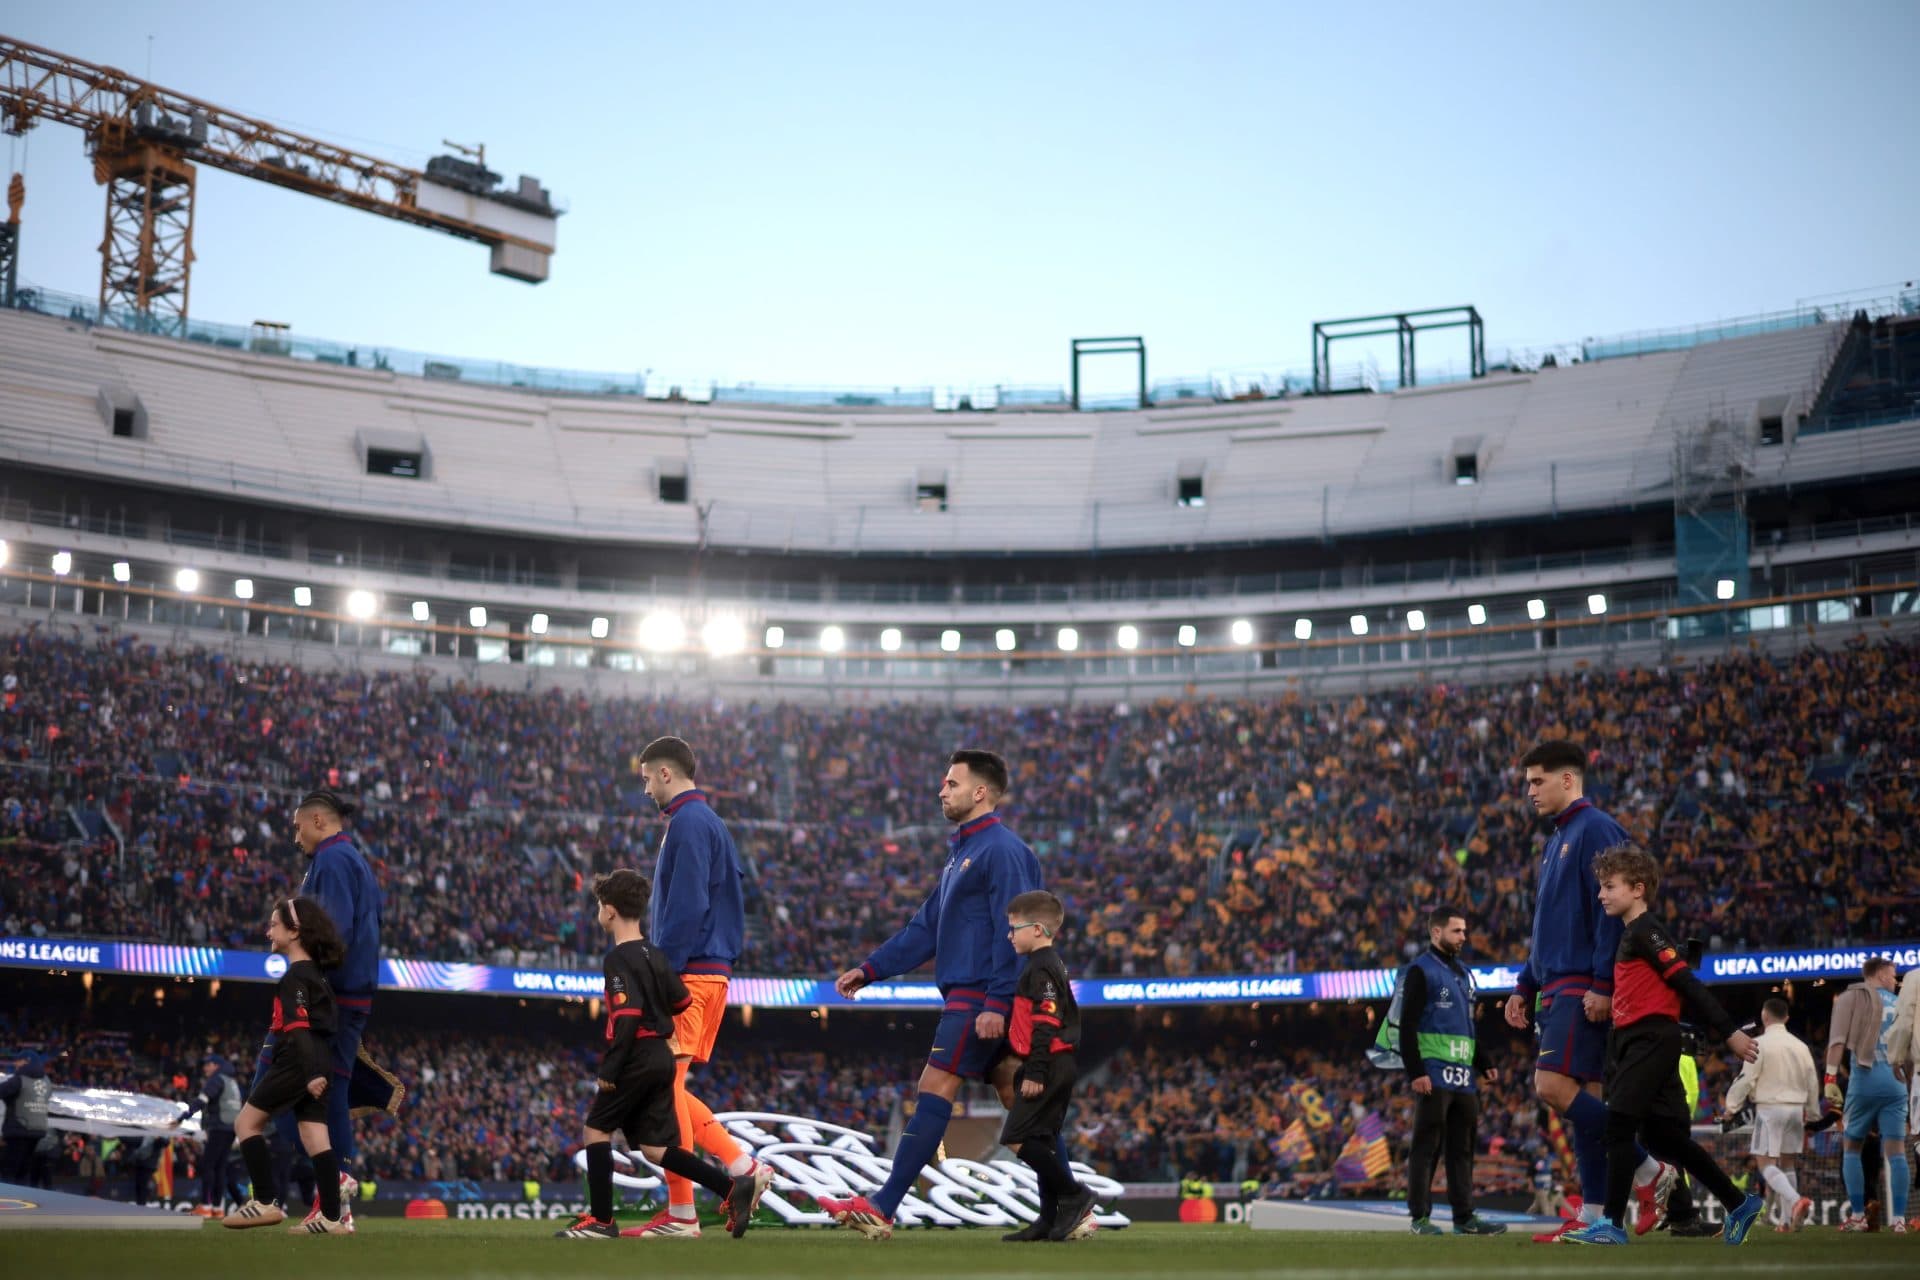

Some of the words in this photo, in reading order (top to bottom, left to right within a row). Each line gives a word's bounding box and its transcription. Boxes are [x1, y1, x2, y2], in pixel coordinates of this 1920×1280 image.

[0, 941, 26, 959] NS
[29, 943, 100, 963] LEAGUE
[1713, 958, 1759, 976] UEFA
[1761, 951, 1868, 973] CHAMPIONS
[1871, 949, 1920, 967] EAG
[513, 972, 553, 990] UEFA
[1103, 984, 1145, 999] UEFA
[1146, 981, 1240, 998] CHAMPIONS
[1241, 978, 1302, 996] LEAGUE
